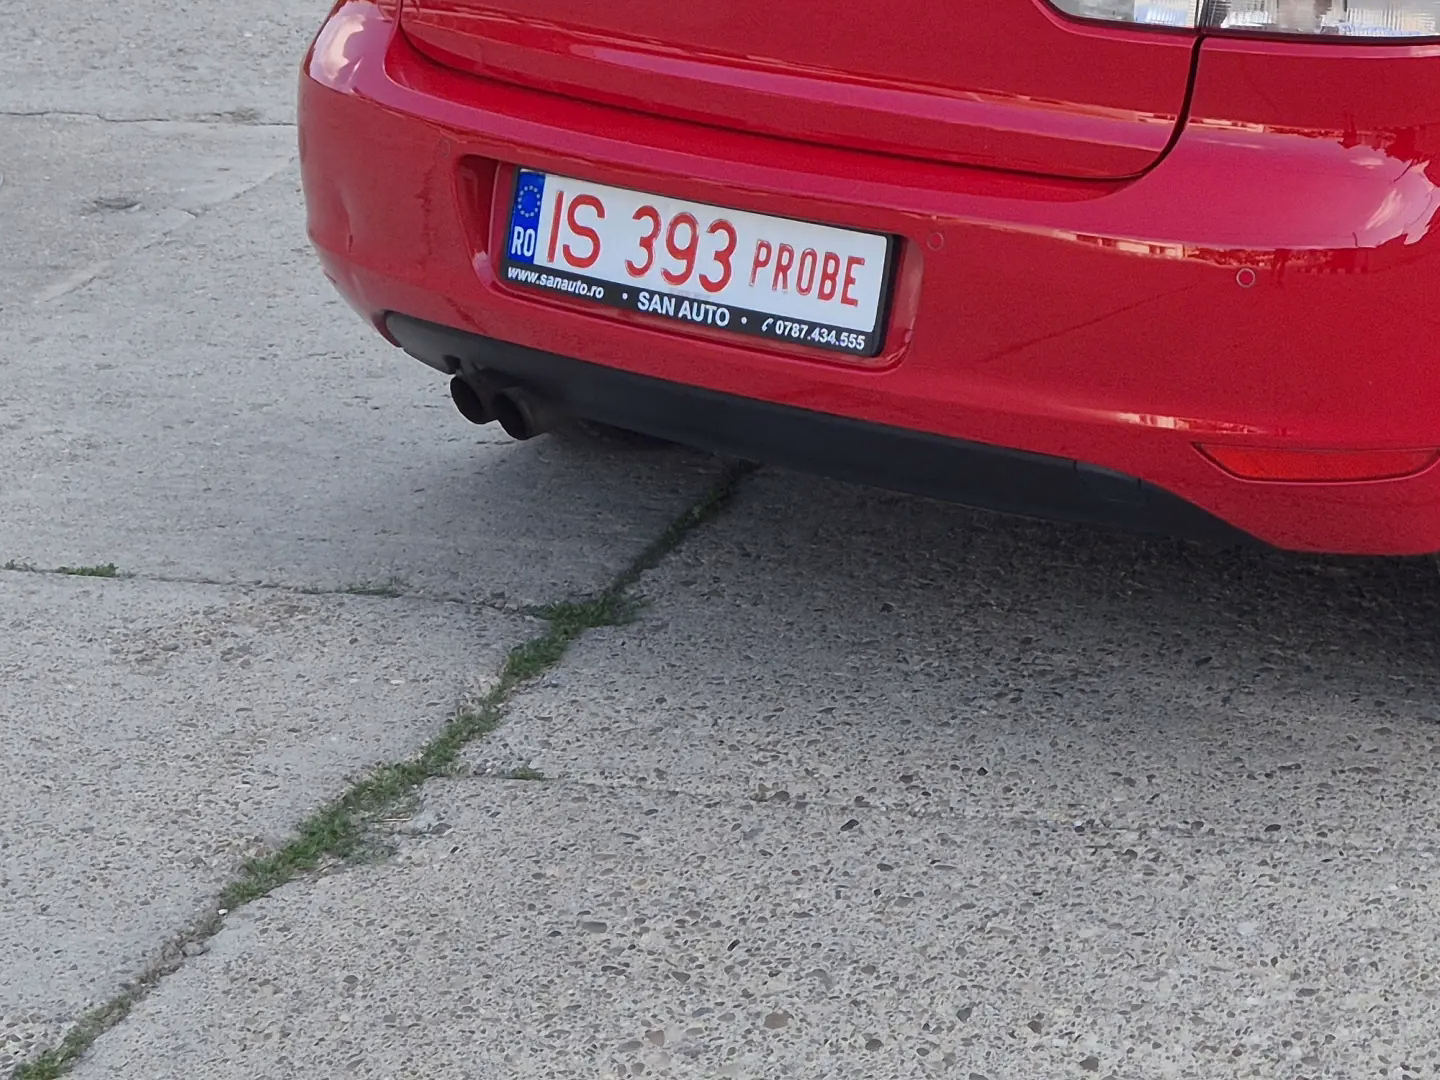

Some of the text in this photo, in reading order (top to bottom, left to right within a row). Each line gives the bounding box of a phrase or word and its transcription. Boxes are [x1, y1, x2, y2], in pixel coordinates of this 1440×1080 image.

[511, 225, 536, 257] RO
[547, 190, 866, 307] IS 393 PROBE
[507, 266, 605, 299] www.sanauto.ro
[637, 291, 675, 317] SAN
[678, 300, 730, 327] AUTO
[775, 320, 866, 351] 0787.434.555
